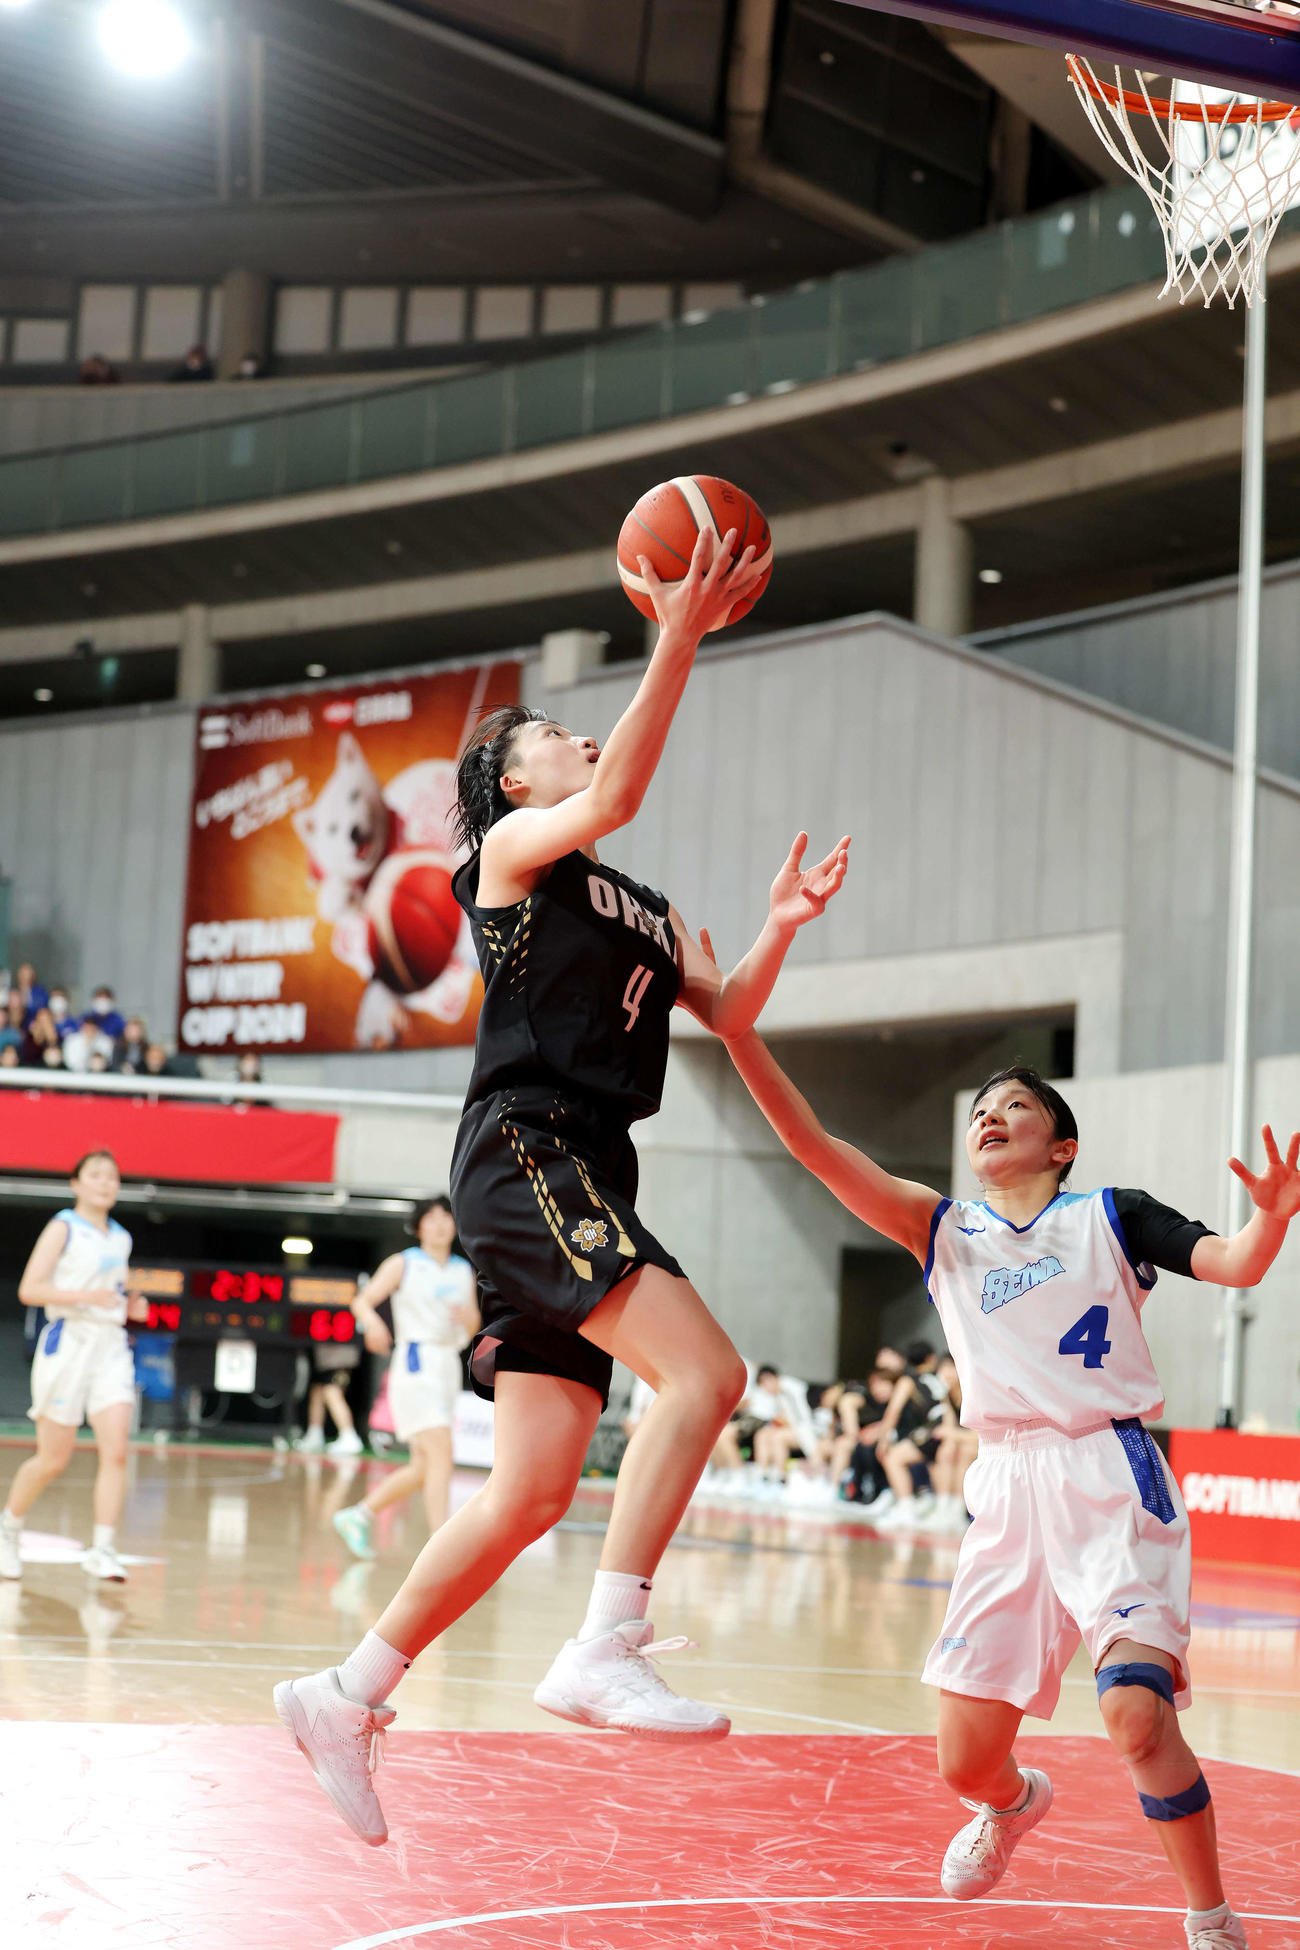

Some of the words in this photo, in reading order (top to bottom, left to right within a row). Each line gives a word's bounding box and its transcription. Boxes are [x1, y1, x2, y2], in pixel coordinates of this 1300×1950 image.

[187, 917, 316, 961] SOFTBANK
[588, 875, 678, 957] OHK
[181, 1006, 236, 1046] CUP
[234, 1002, 306, 1045] 2024
[622, 964, 655, 1033] 4
[1058, 1305, 1111, 1369] 4
